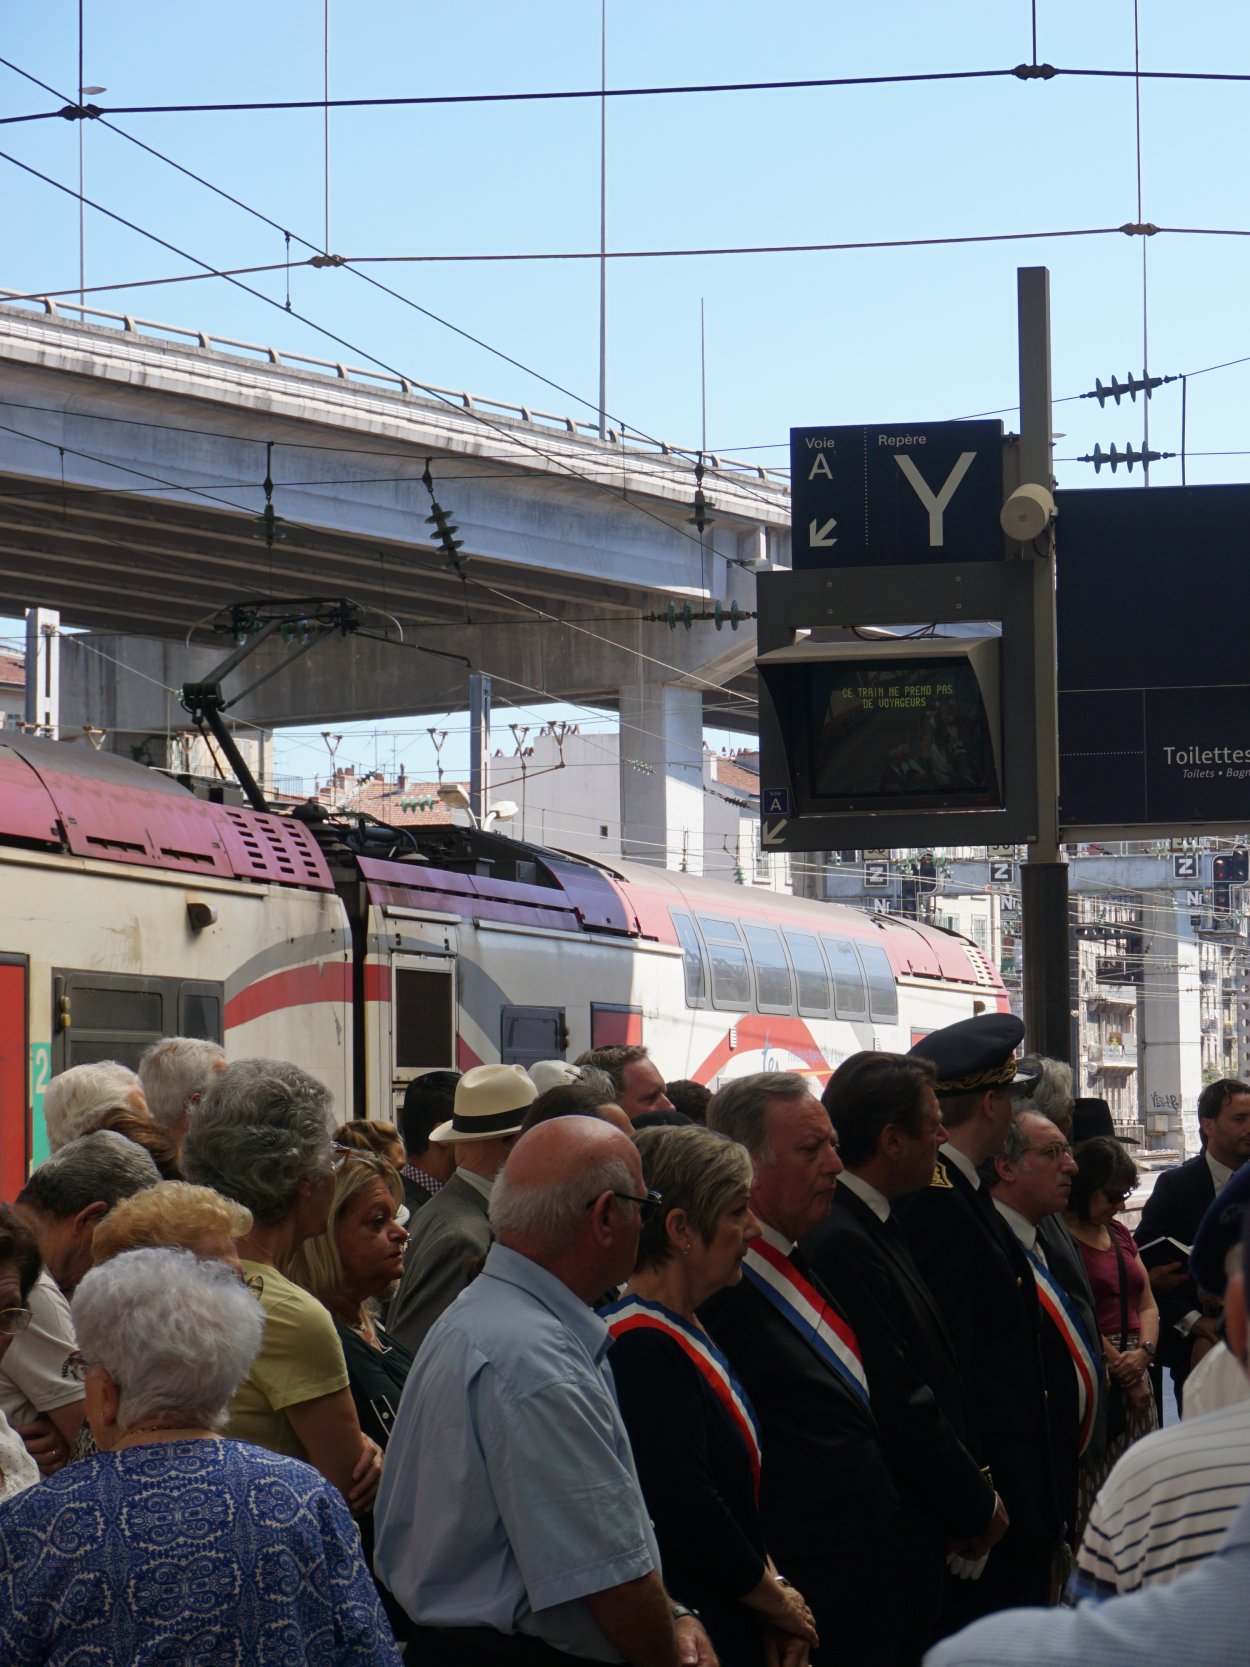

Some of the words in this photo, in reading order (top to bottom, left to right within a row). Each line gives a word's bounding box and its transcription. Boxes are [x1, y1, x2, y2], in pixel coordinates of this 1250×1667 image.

[805, 437, 835, 449] Voie
[878, 433, 927, 447] Repère
[808, 453, 834, 480] A
[893, 451, 978, 547] Y
[842, 688, 853, 698] CE
[858, 687, 884, 697] TRAIN
[889, 686, 900, 696] NE
[905, 685, 932, 695] PREND
[936, 684, 953, 694] PAS
[863, 699, 874, 709] DE
[880, 697, 927, 708] VOYAGEURS
[1183, 769, 1215, 779] Toilets
[769, 798, 782, 811] A
[994, 863, 1008, 879] Z
[1179, 858, 1192, 874] Z
[870, 867, 883, 882] Z
[1187, 890, 1203, 905] Nr
[35, 1048, 48, 1094] 2
